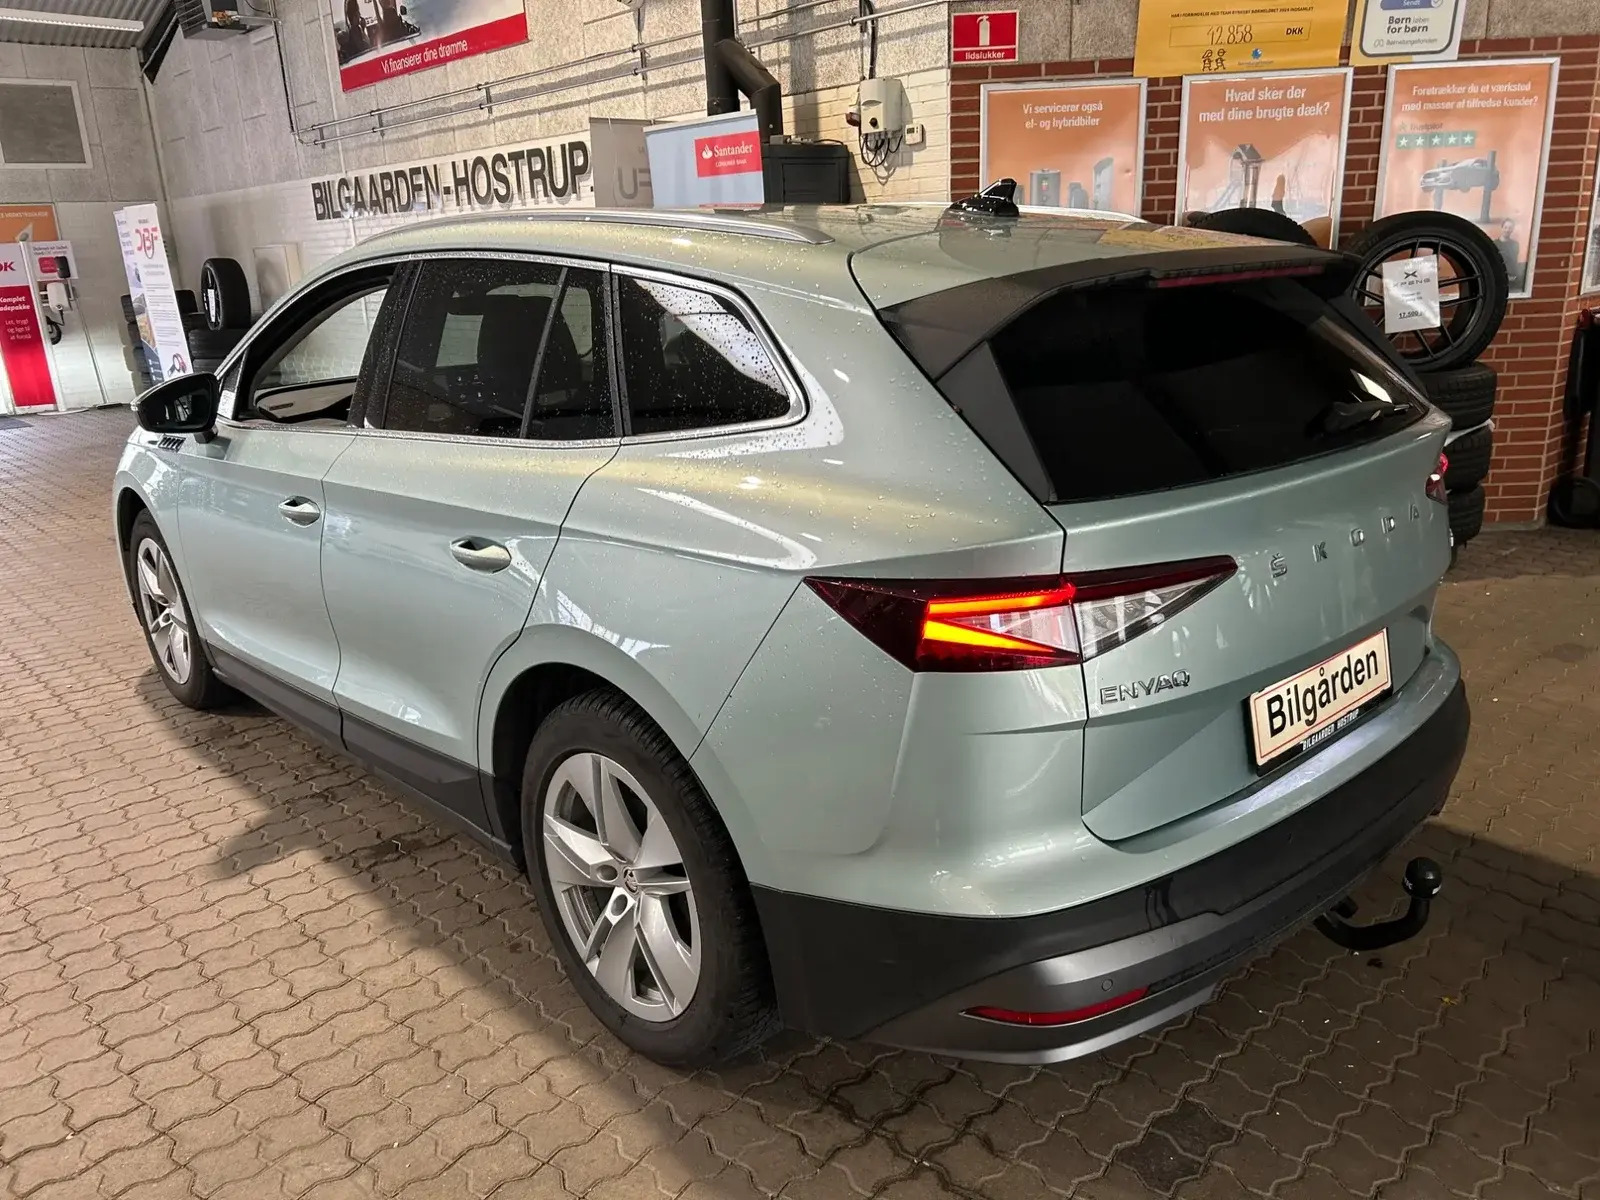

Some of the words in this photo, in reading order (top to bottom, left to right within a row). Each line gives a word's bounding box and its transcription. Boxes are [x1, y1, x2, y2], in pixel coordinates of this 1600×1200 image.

[1388, 16, 1411, 24] Børn
[1286, 27, 1303, 35] DKK
[1387, 26, 1402, 34] for
[1404, 25, 1428, 33] børn
[389, 52, 422, 73] finansierer
[423, 47, 438, 62] dine
[438, 40, 468, 58] drømme
[1225, 88, 1255, 102] Hvad
[1258, 87, 1284, 100] sker
[1287, 86, 1307, 99] der
[1468, 84, 1478, 94] du
[1481, 84, 1490, 93] et
[1023, 104, 1032, 114] Vi
[1034, 103, 1080, 113] servicerer
[1081, 100, 1103, 113] også
[1402, 101, 1421, 111] med
[1424, 101, 1454, 110] masser
[1457, 99, 1466, 109] af
[1467, 98, 1502, 108] tilfredse
[1504, 96, 1538, 107] kunder?
[1199, 108, 1224, 122] med
[1228, 107, 1253, 120] dine
[1256, 105, 1294, 120] brugte
[1297, 102, 1330, 116] dæk?
[1025, 118, 1037, 129] el-
[1040, 120, 1050, 130] og
[1053, 116, 1100, 129] hybridbiler
[714, 141, 753, 157] Santander
[1269, 503, 1420, 578] ŠKODA
[1100, 668, 1190, 704] ENYAQ
[1266, 649, 1379, 738] Bilgården
